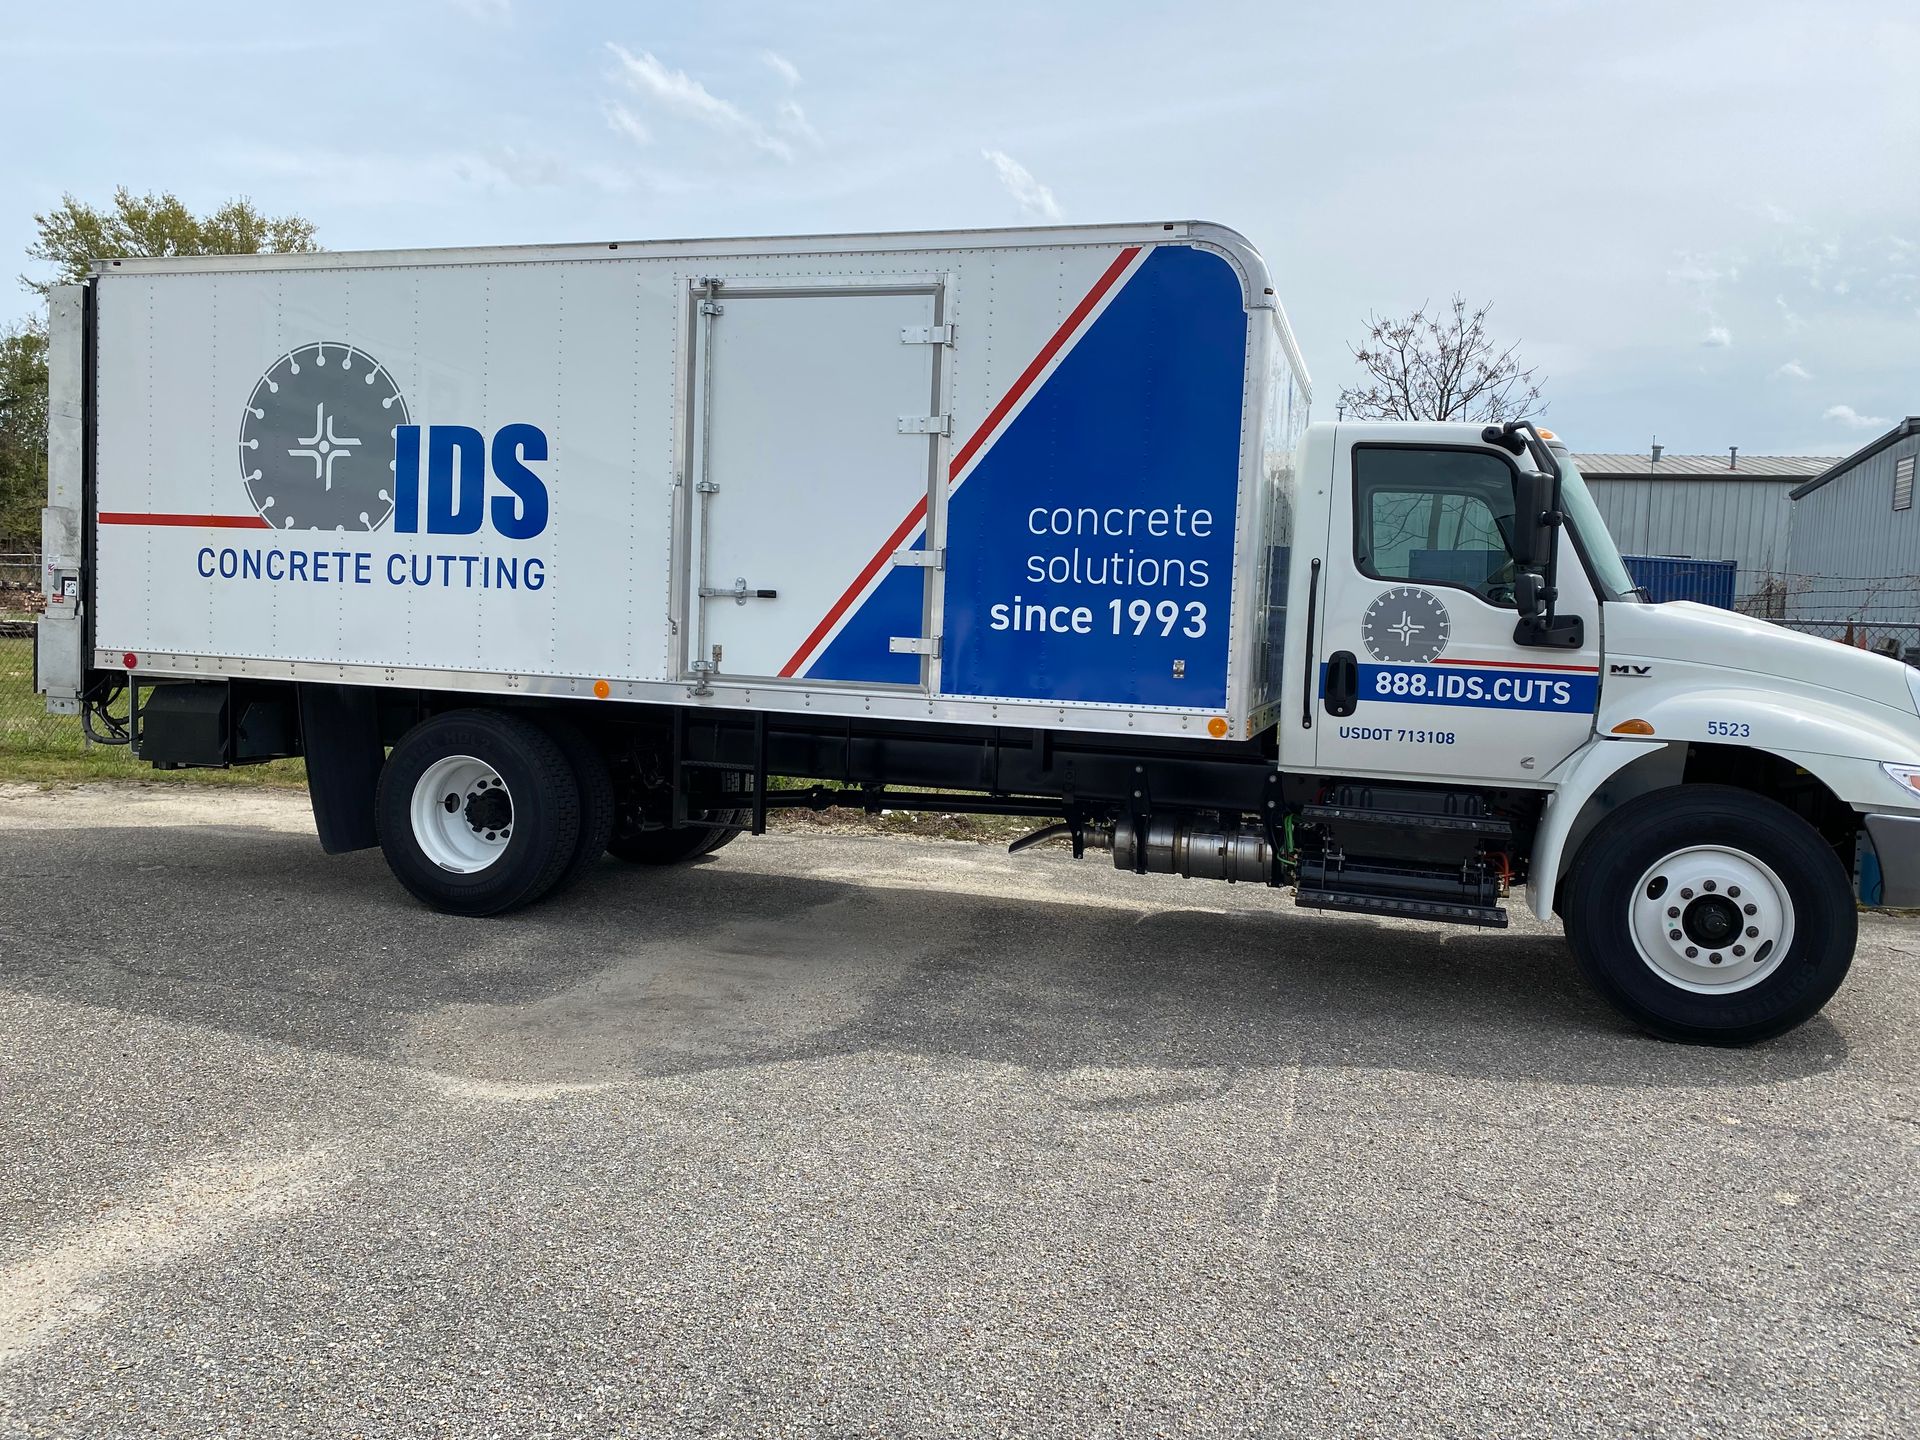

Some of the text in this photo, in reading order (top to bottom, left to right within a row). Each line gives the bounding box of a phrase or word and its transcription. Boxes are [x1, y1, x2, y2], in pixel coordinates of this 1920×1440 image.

[395, 423, 549, 540] IDS
[1028, 504, 1213, 537] concrete
[198, 548, 544, 591] CONCRETE CUTTING
[1026, 549, 1209, 587] solutions
[990, 596, 1207, 639] since 1993
[1610, 664, 1652, 675] MV
[1375, 671, 1571, 704] 888.IDS.CUTS
[1339, 726, 1455, 745] USDOT 713108
[1708, 721, 1750, 737] 5523
